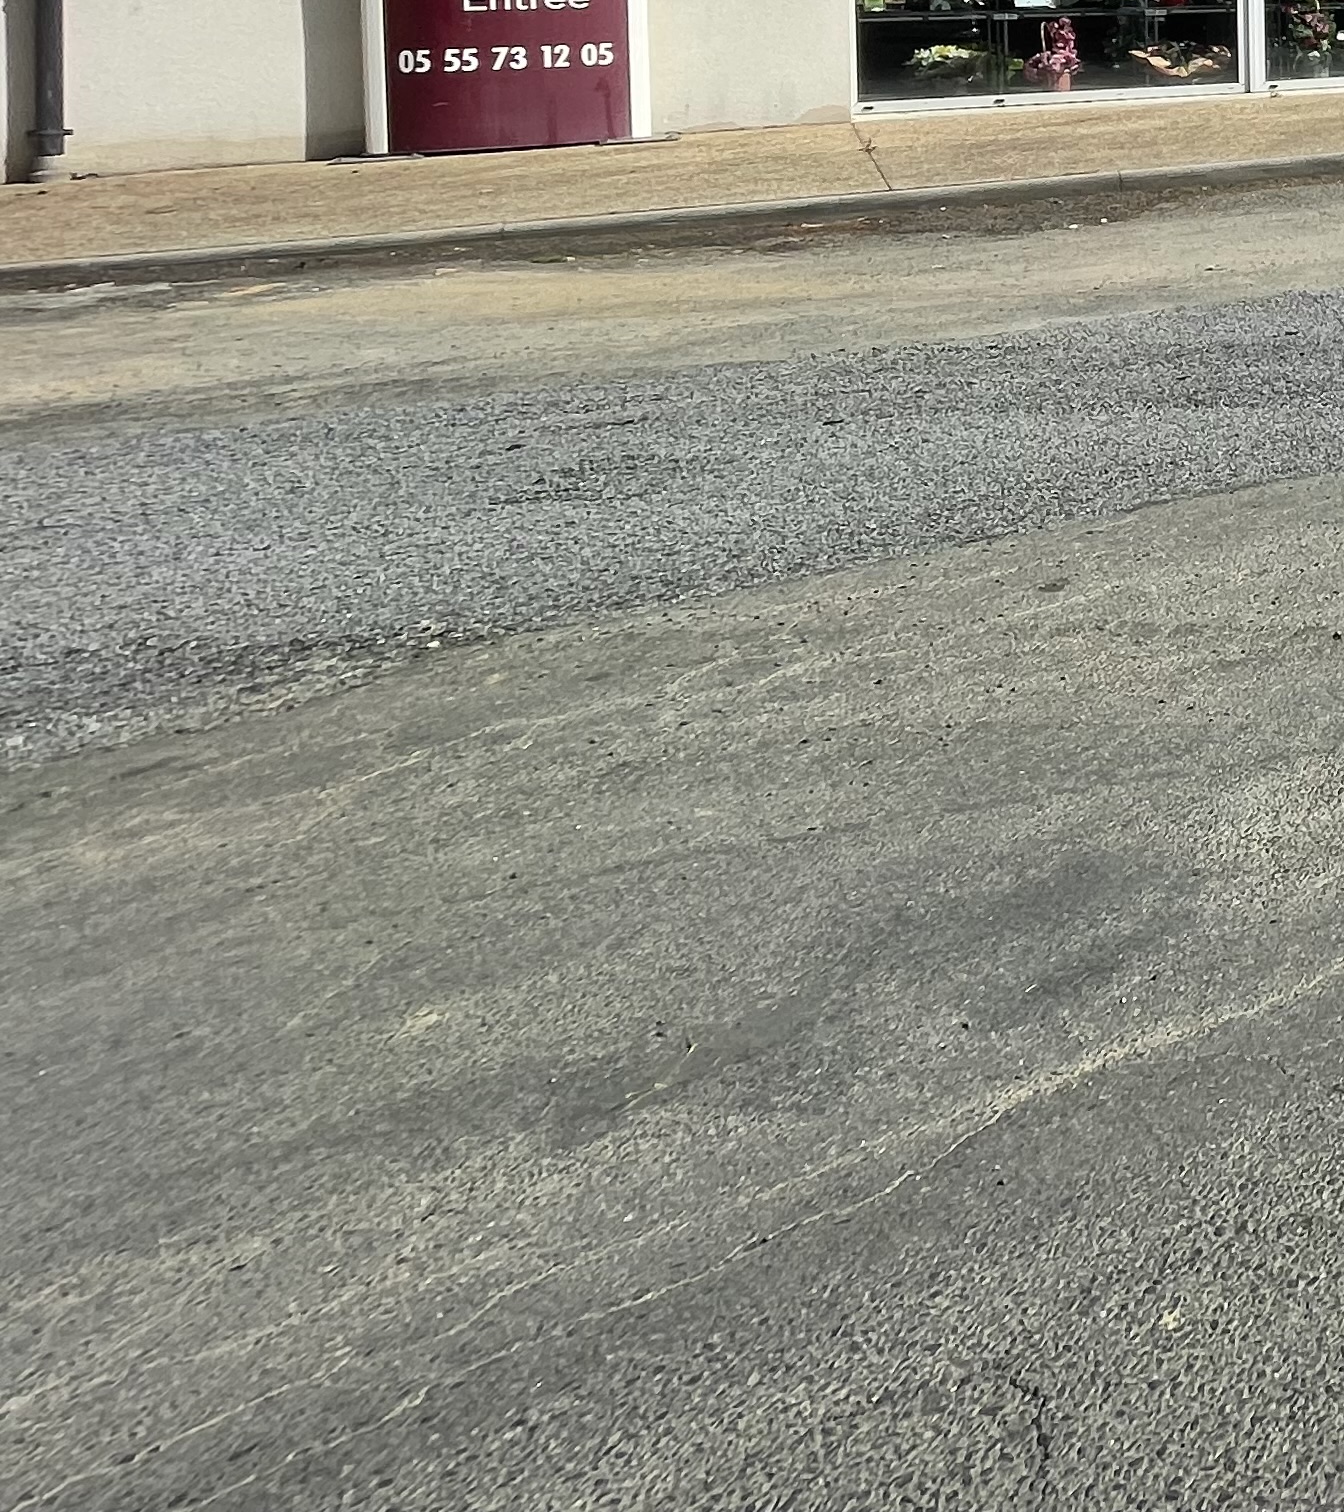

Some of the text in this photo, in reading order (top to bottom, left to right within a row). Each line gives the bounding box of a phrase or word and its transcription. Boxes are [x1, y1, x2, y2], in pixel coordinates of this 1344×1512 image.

[398, 42, 615, 74] 05 55 73 12 05
